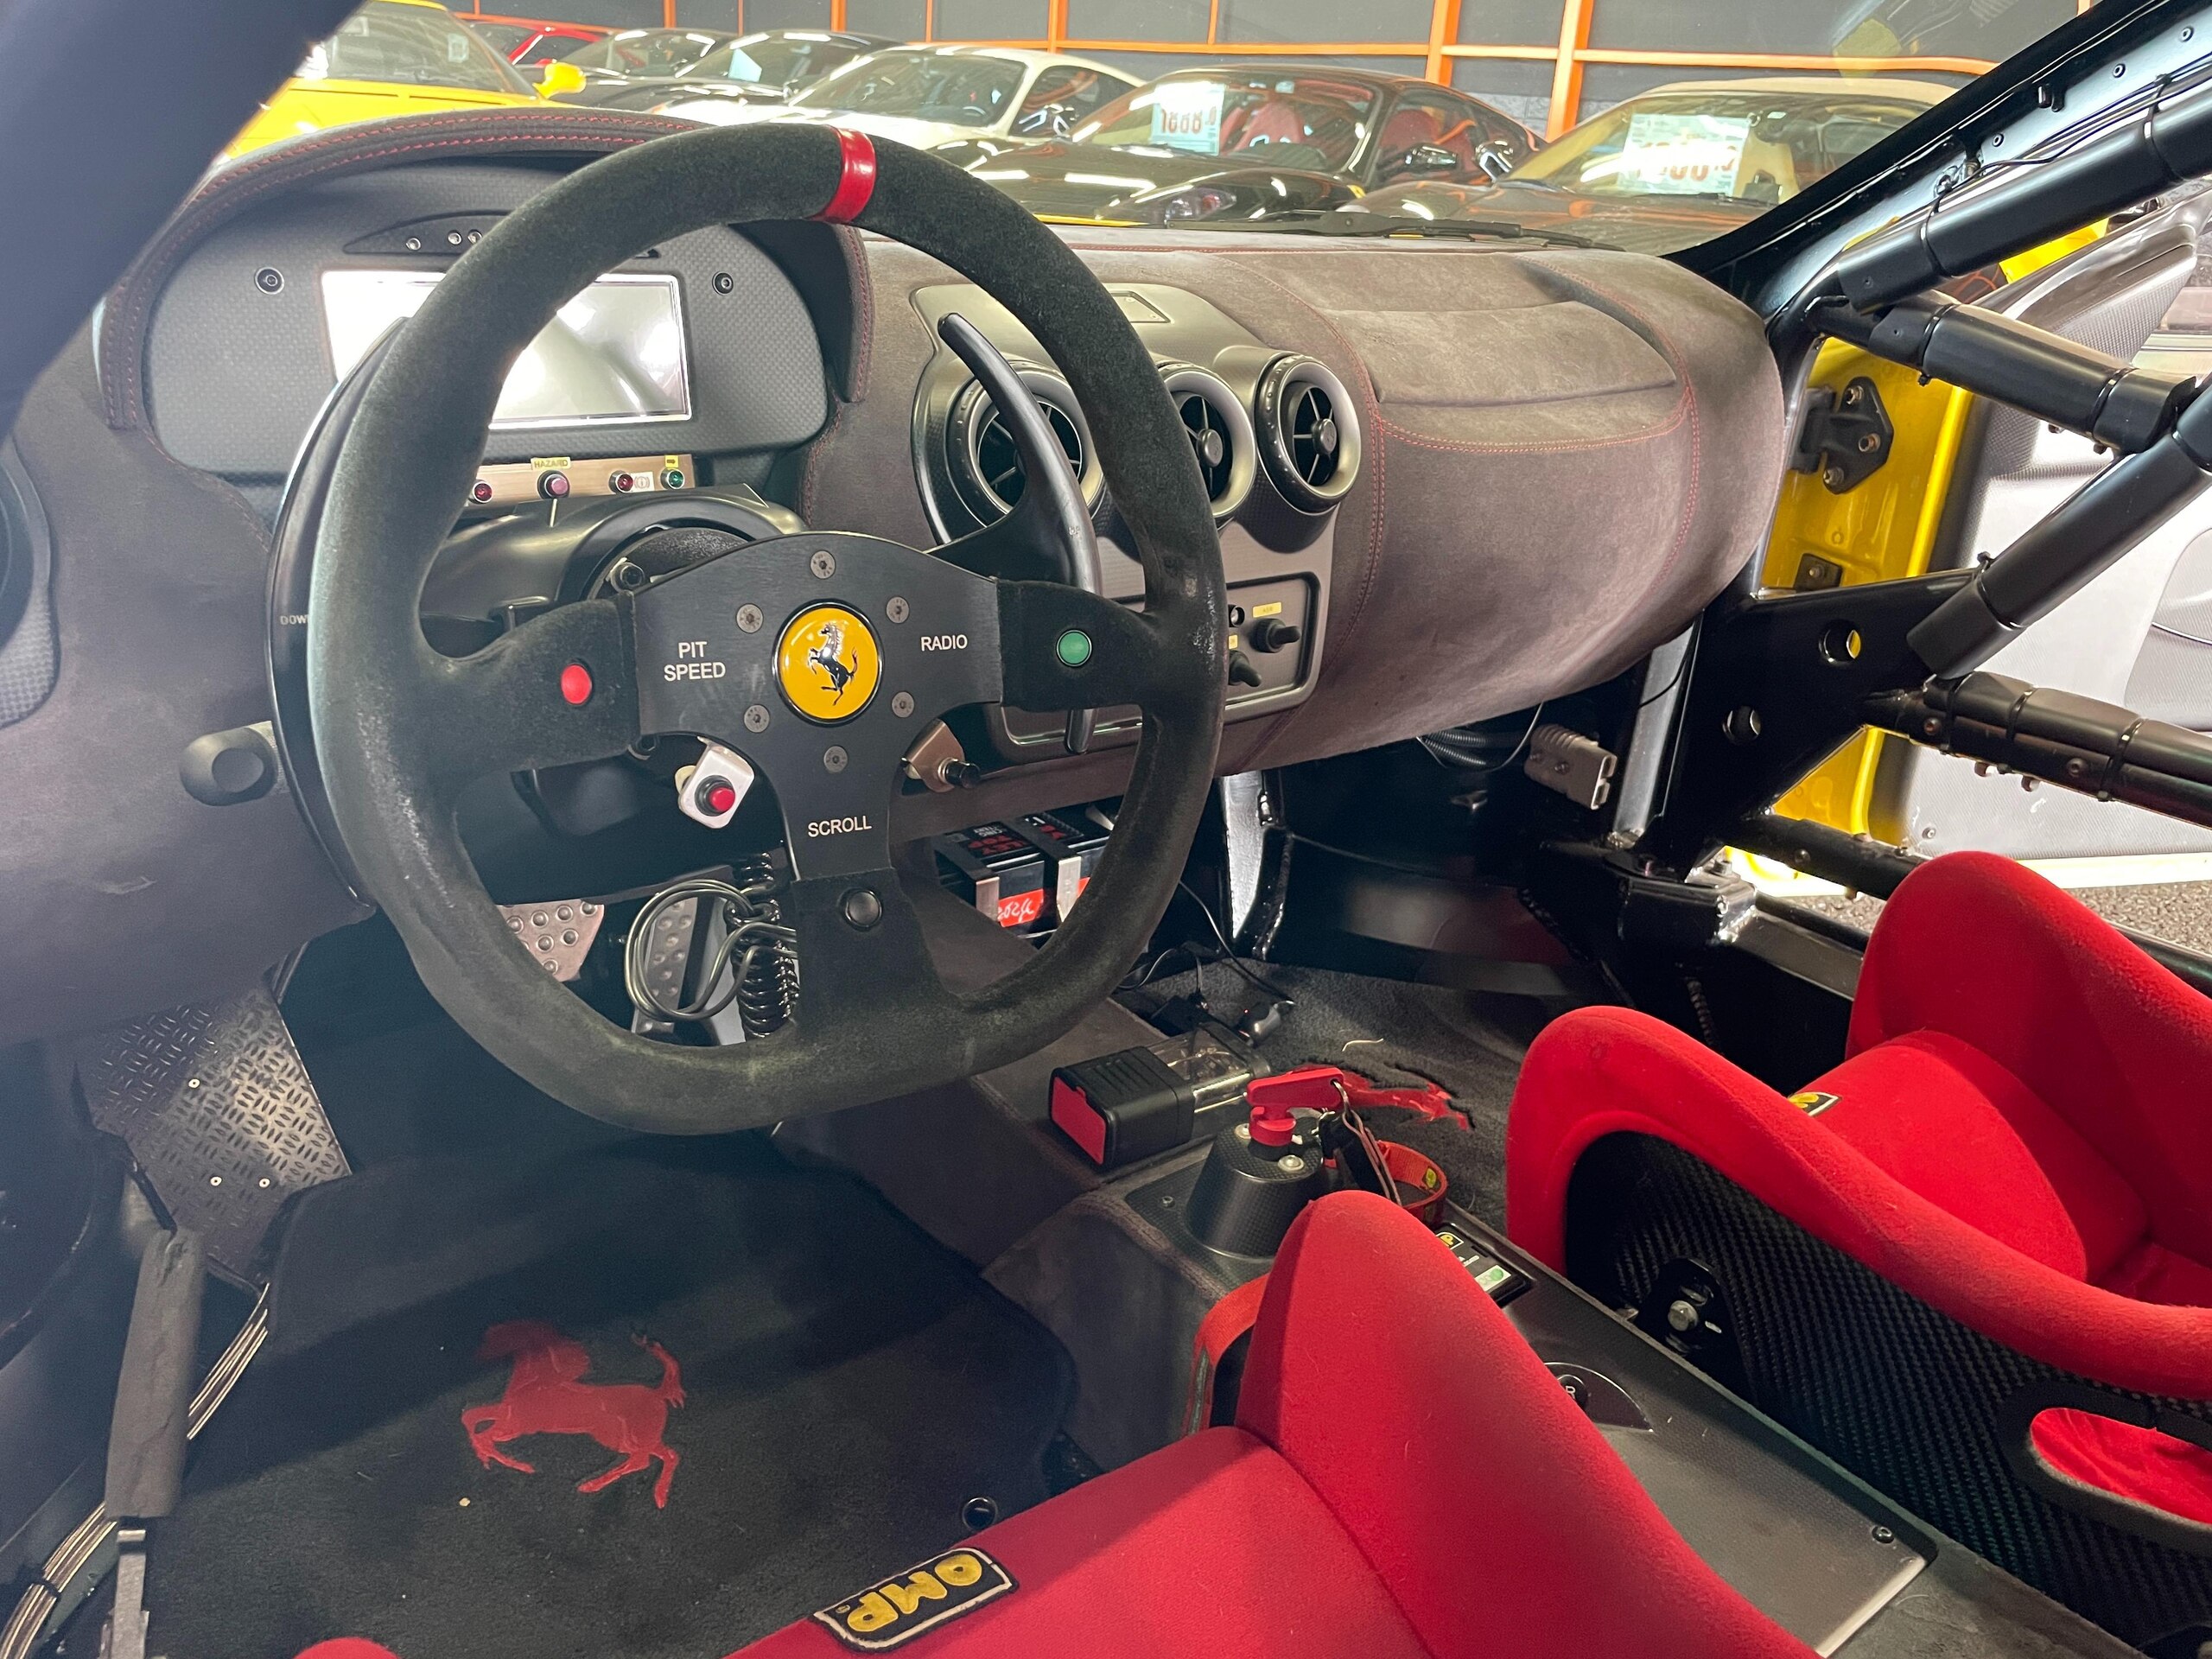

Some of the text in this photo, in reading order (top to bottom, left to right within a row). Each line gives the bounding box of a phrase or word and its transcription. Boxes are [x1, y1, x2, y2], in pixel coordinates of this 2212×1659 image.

[534, 459, 568, 467] HAZARD
[280, 614, 309, 625] DOW
[678, 641, 707, 658] PIT
[921, 634, 968, 652] RADIO
[664, 662, 726, 682] SPEED
[808, 815, 872, 837] SCROLL
[1565, 1385, 1576, 1400] R
[847, 1554, 982, 1631] OMP
